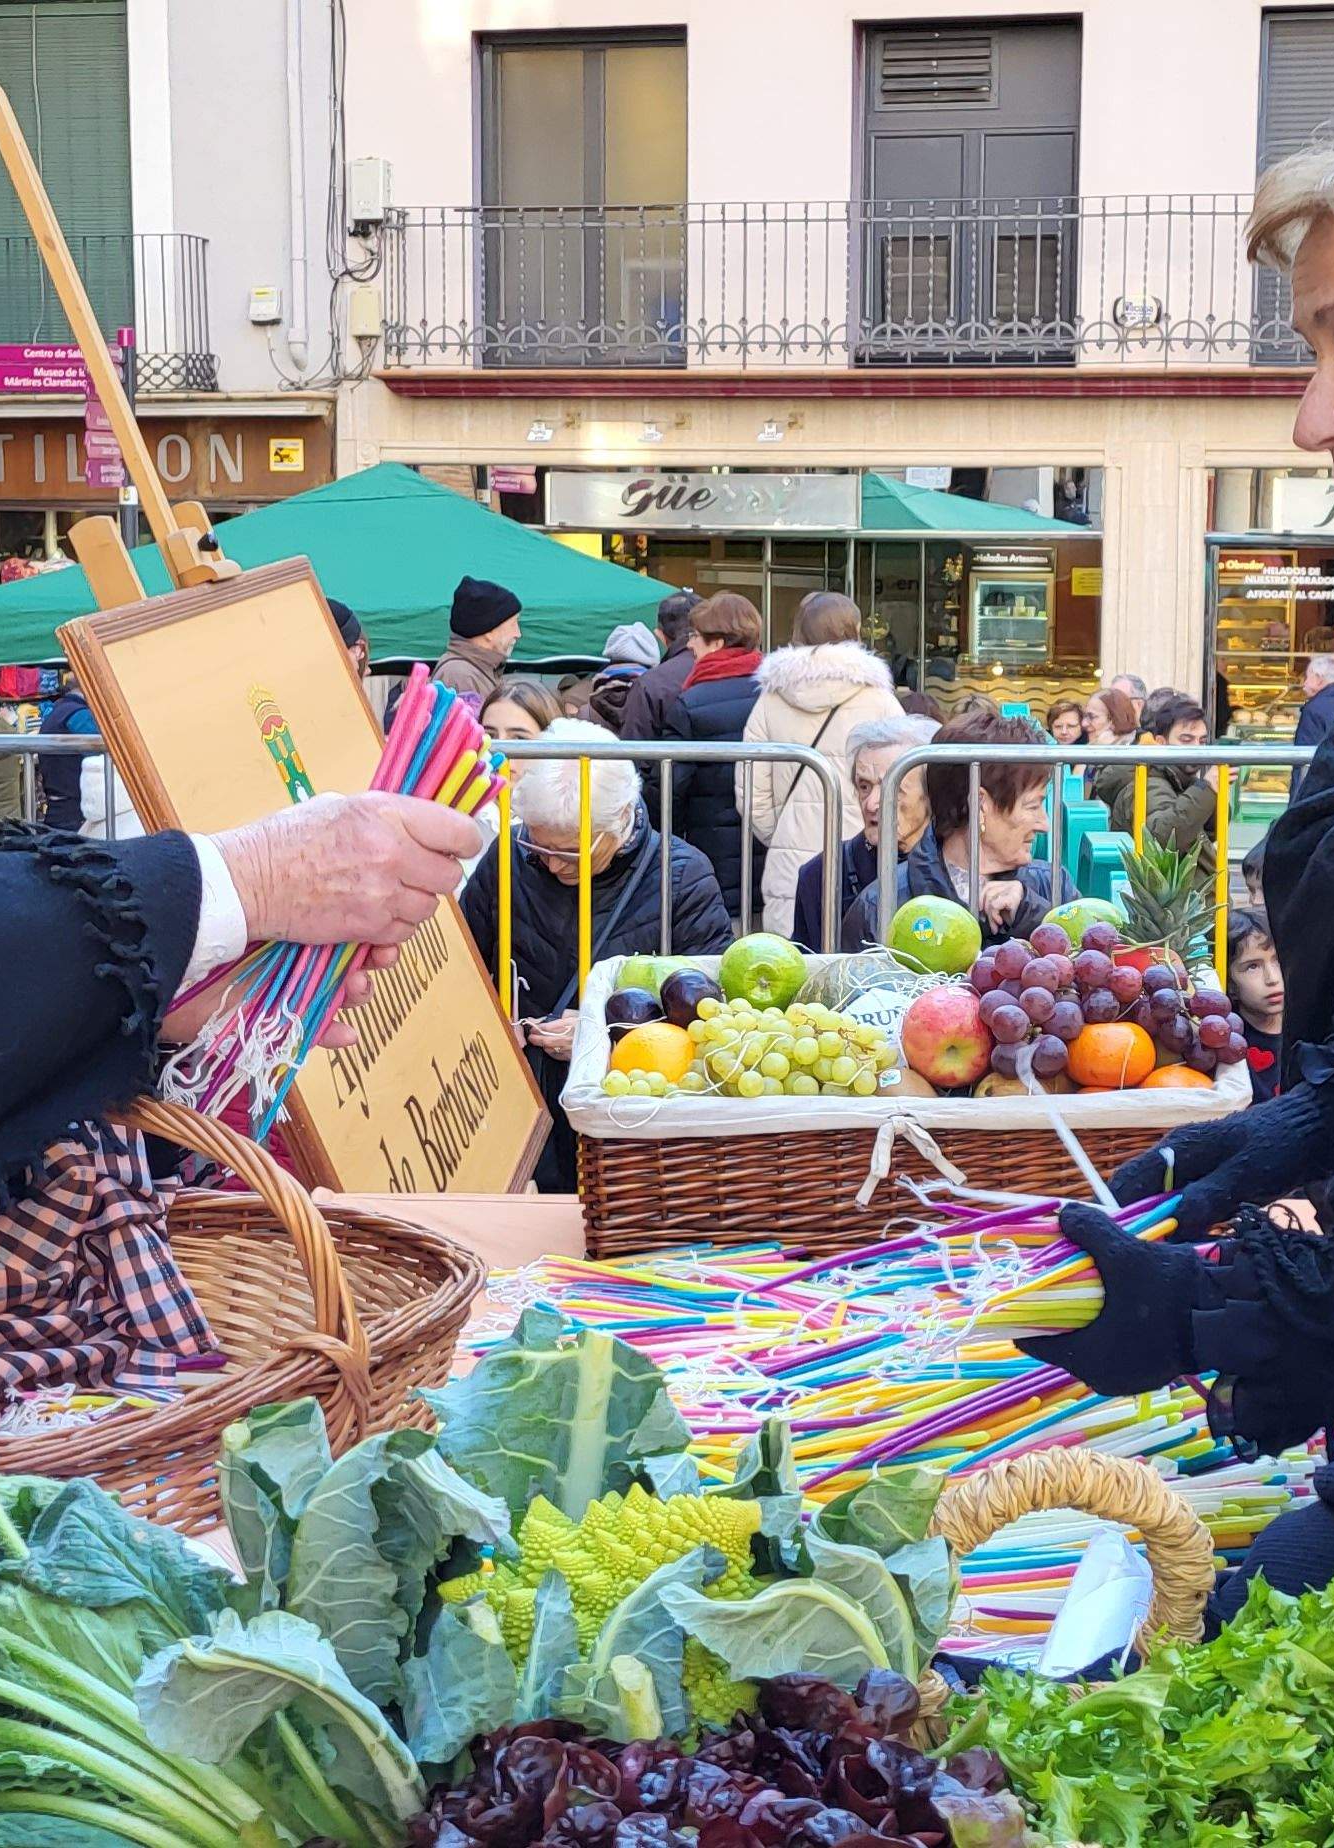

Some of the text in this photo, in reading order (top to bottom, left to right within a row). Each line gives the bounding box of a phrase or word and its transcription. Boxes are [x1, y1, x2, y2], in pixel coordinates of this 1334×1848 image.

[23, 348, 54, 359] Centro
[54, 348, 66, 359] de
[33, 367, 65, 378] Museo
[65, 367, 77, 378] de
[3, 376, 42, 388] Mártires
[1262, 566, 1321, 576] HELADOS DE
[1244, 575, 1289, 585] NUESTRO
[1294, 589, 1307, 600] AL
[403, 1029, 500, 1194] Barbastro
